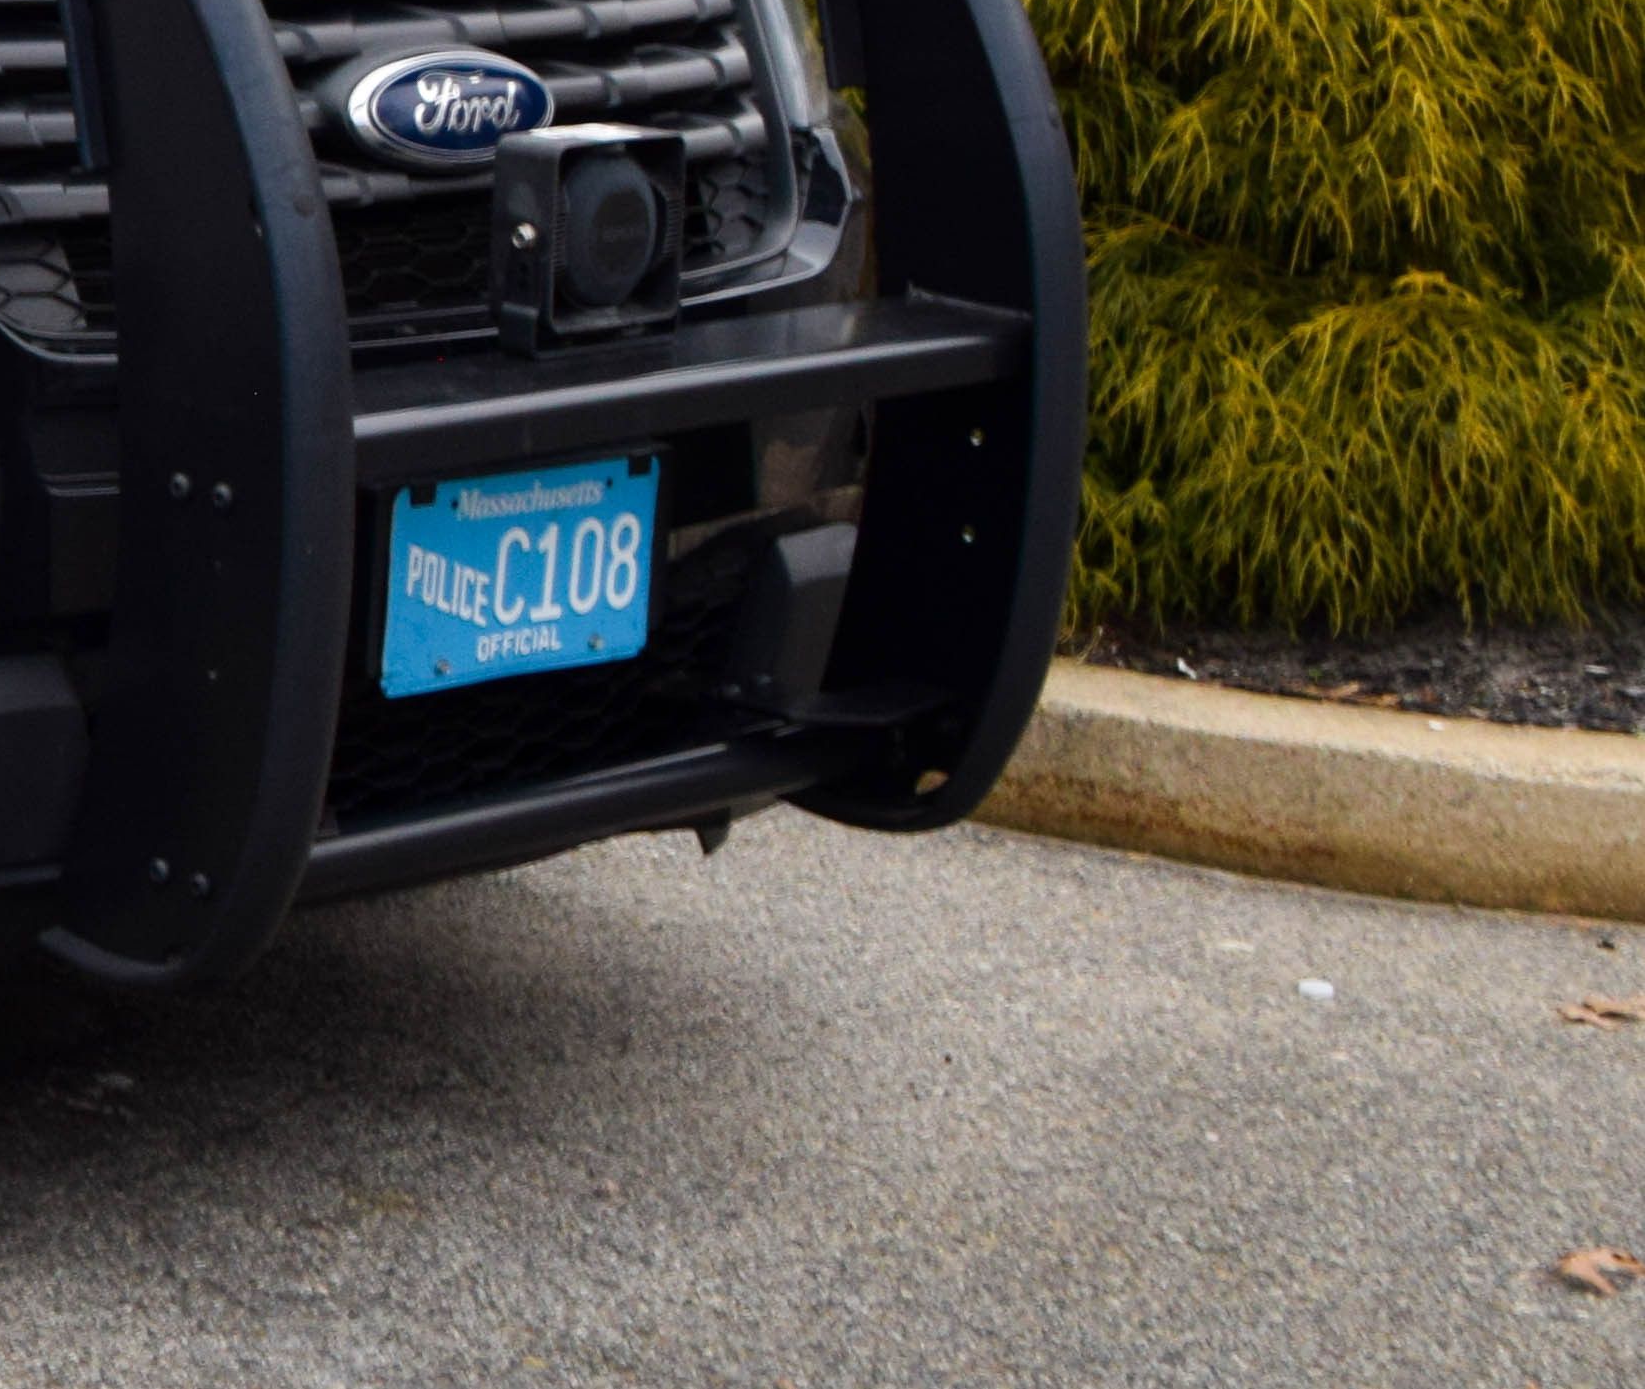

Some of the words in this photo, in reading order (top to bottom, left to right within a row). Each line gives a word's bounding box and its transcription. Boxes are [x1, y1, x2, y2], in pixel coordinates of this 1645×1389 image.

[414, 68, 521, 136] Ford
[456, 479, 606, 521] Massachusetts
[406, 544, 491, 628] POLICE
[492, 512, 642, 627] C108
[476, 627, 563, 663] OFFICIAL
